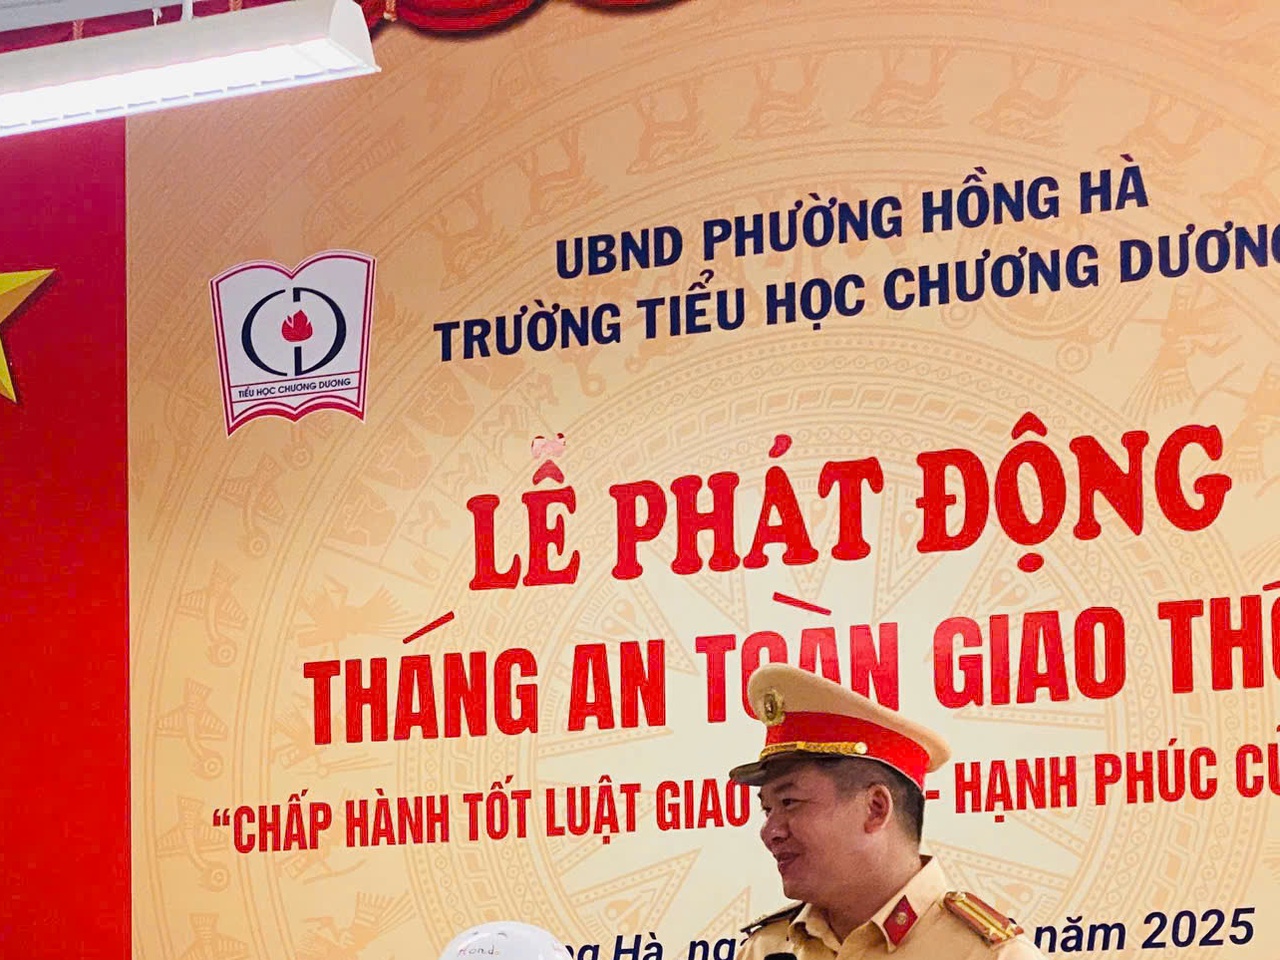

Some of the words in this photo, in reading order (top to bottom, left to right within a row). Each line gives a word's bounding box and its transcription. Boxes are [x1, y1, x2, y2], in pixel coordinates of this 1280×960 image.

[557, 226, 683, 280] UBND
[703, 192, 902, 261] PHƯỜNG
[922, 166, 1059, 234] HỒNG
[1079, 153, 1149, 214] HÀ
[433, 300, 621, 362] TRƯỜNG
[637, 269, 745, 339] TIỂU
[766, 278, 865, 331] HỌC
[883, 244, 1099, 311] CHƯƠNG
[277, 382, 317, 394] CHƯƠNG
[318, 378, 351, 390] DƯƠNG
[609, 434, 884, 580] PHÁT
[915, 411, 1233, 574] ĐỘNG
[303, 610, 539, 746] THÁNG
[567, 638, 666, 732] AN
[695, 591, 900, 724] TOÀN
[933, 606, 1126, 709] GIAO
[1157, 580, 1280, 694] TH
[345, 788, 450, 848] HÀNH
[462, 774, 533, 842] TỐT
[545, 774, 641, 845] LUẬT
[656, 778, 750, 832] GIAO
[954, 755, 1077, 823] HẠNH
[1094, 737, 1218, 806] PHÚC
[1034, 914, 1127, 954] năm
[1141, 907, 1256, 949] 2025
